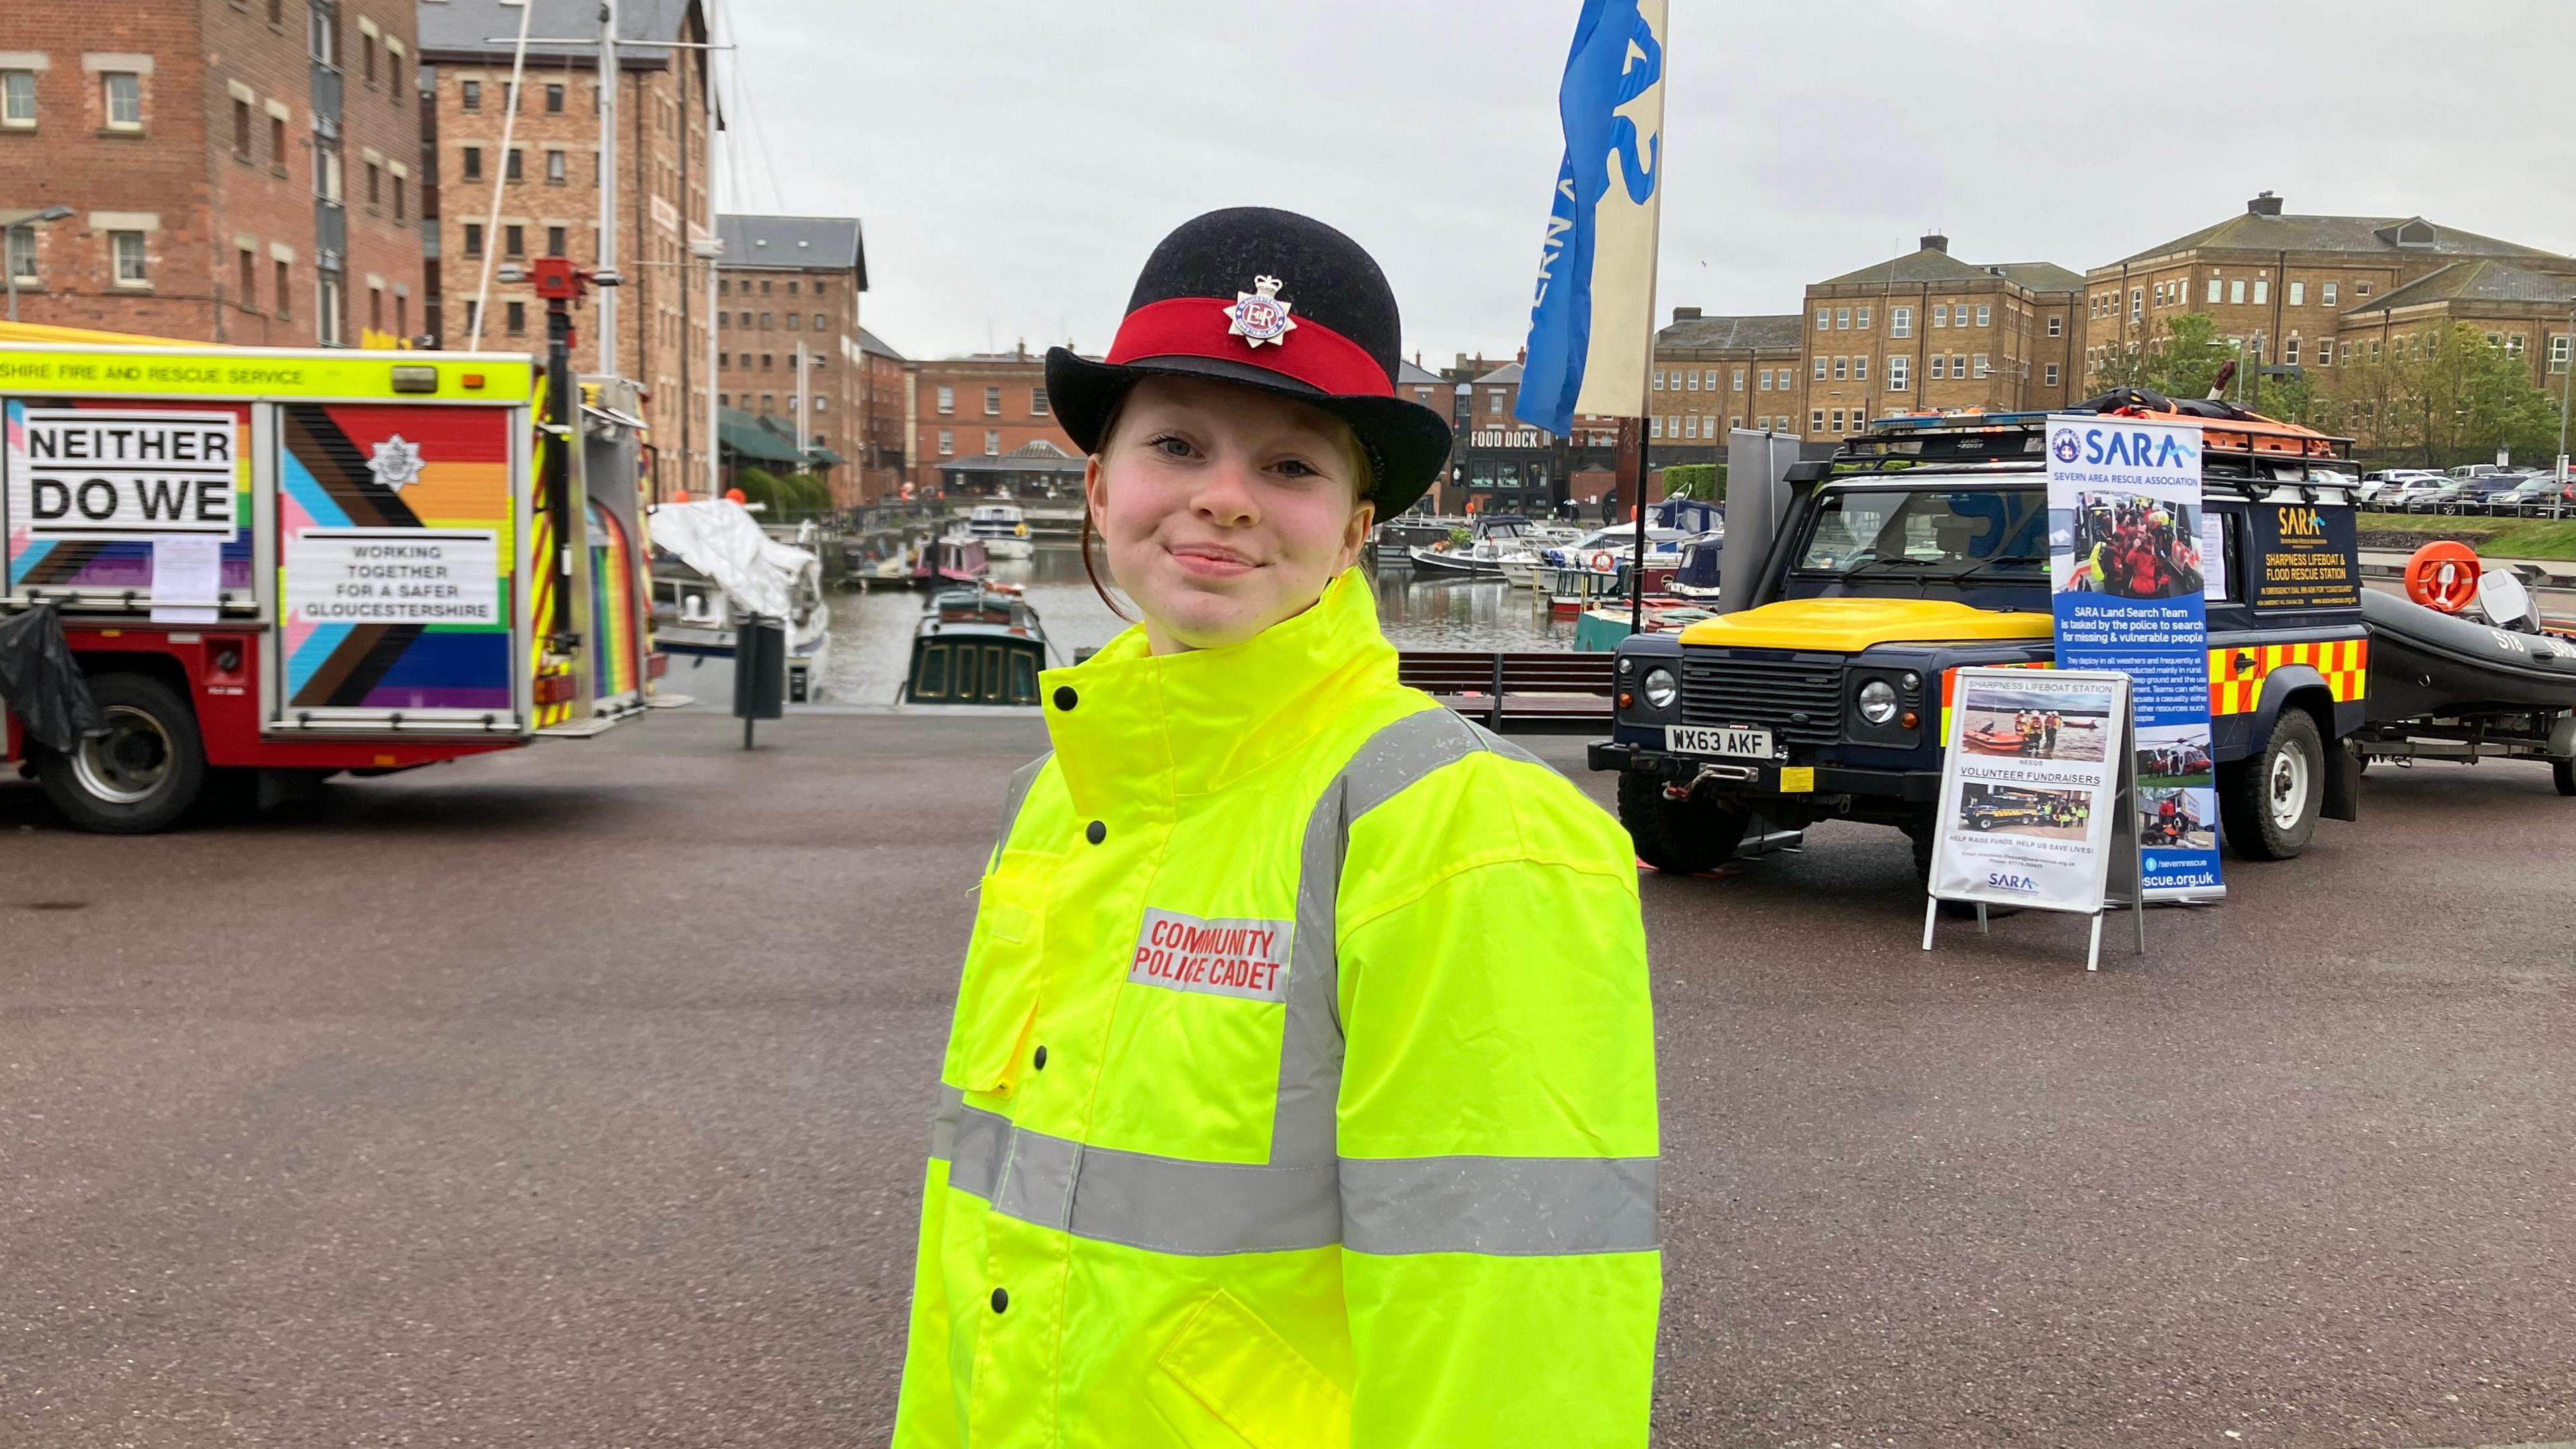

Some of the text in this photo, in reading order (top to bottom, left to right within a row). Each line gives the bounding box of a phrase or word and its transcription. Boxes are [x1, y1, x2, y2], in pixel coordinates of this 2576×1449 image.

[58, 364, 98, 380] FIRE
[107, 366, 140, 380] AND
[148, 367, 221, 383] RESCUE
[227, 368, 303, 385] SERVICE
[30, 429, 229, 461] NEITHER
[1471, 431, 1538, 448] FOOD DOCK
[2086, 429, 2184, 468] SARA
[2054, 472, 2198, 486] SEVERN AREA RESCUE ASSOCIATION
[32, 478, 229, 521] DO WE
[2279, 507, 2320, 535] SARA
[352, 547, 442, 559] WORKING
[2266, 553, 2345, 566] SHARPNESS LIFEBOAT &
[347, 566, 447, 578] TOGETHER
[2267, 568, 2346, 581] FLOOD RESCUE STATION
[336, 584, 459, 598] FOR A SAFER
[307, 604, 489, 618] GLOUCESTERSHIRE
[2075, 606, 2188, 617] SARA Land Search Team
[2061, 619, 2204, 631] is tasked by the police to search
[2063, 631, 2203, 644] for missing & vulnerable people
[2491, 631, 2524, 652] S18
[2079, 657, 2099, 665] deploy
[2160, 657, 2194, 665] frequently
[2157, 667, 2178, 675] mainly
[1968, 680, 2112, 693] SHARPNESS LIFEBOAT STATION
[2147, 677, 2169, 685] ground
[2161, 695, 2188, 703] casualty
[1673, 729, 1763, 754] WX63 AKF
[1961, 767, 2100, 784] VOLUNTEER FUNDRAISERS
[1989, 873, 2033, 890] SARA
[1150, 919, 1275, 959] COMMUNITY
[1132, 946, 1280, 991] POLICE CADET
